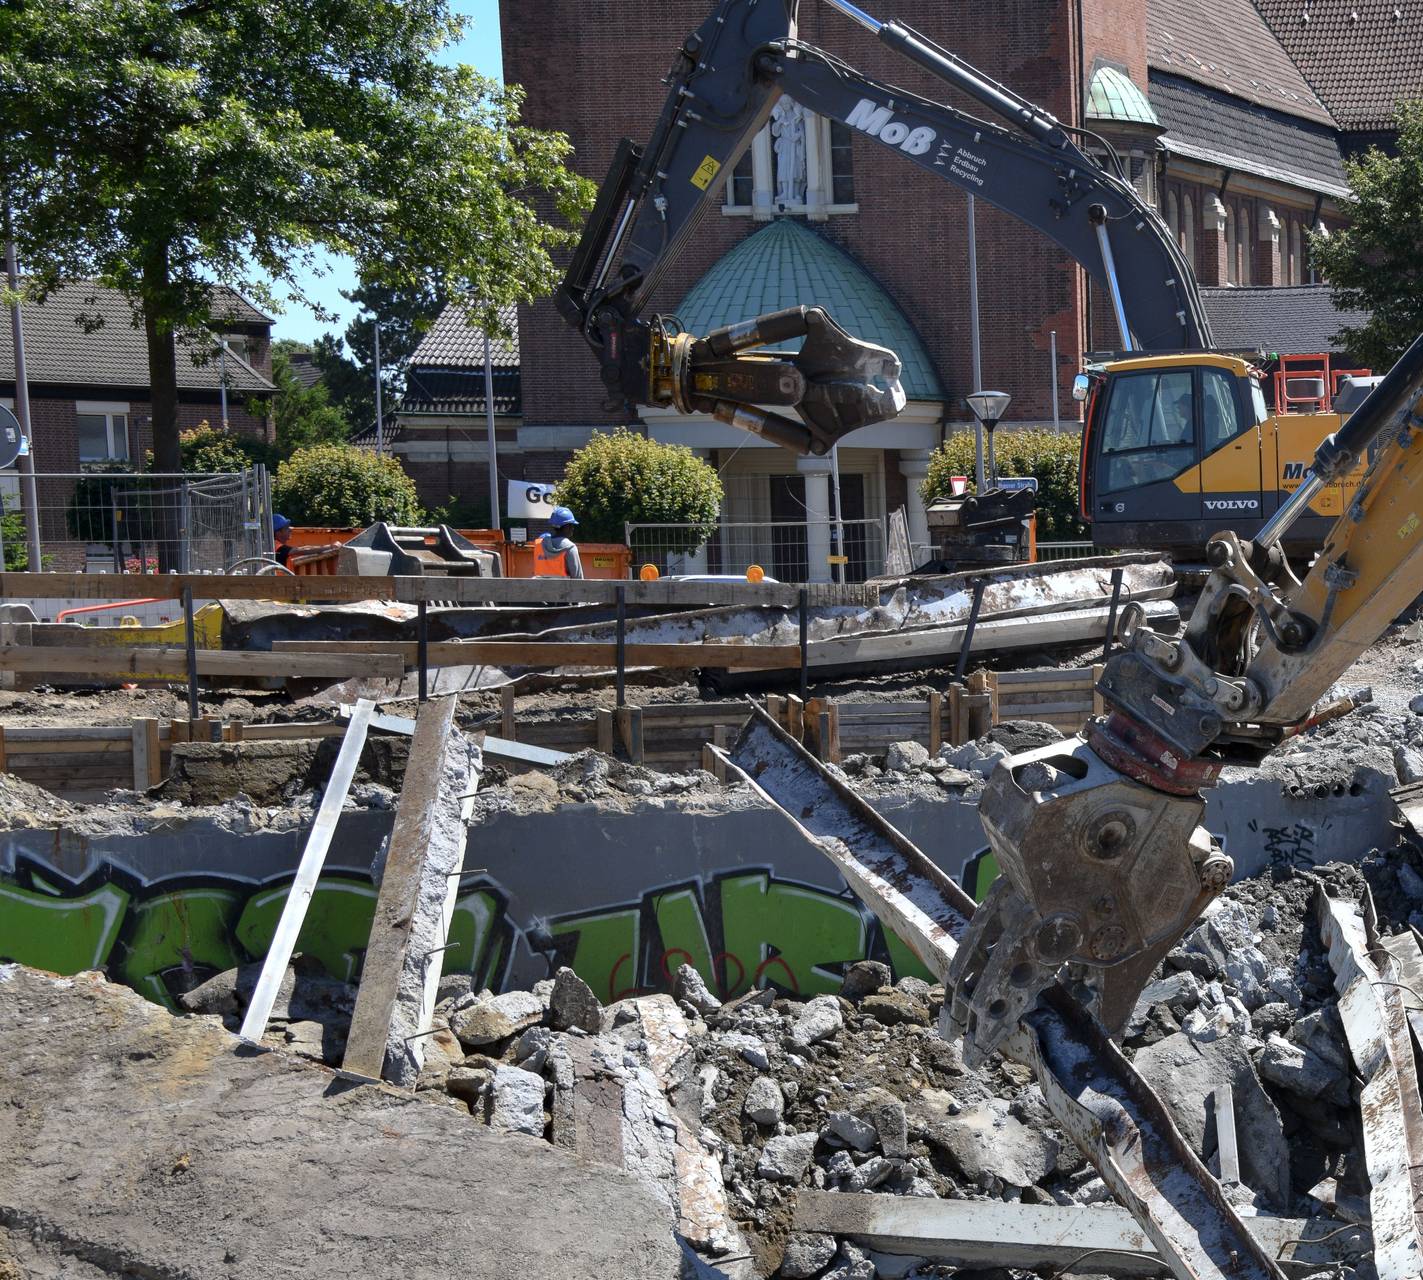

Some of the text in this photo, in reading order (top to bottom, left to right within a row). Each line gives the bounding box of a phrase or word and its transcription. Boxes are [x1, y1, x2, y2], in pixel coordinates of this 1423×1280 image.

[845, 98, 936, 155] Moß
[953, 156, 979, 173] Erdbau
[956, 147, 987, 167] Abbruch
[950, 164, 984, 186] Recycling
[1204, 500, 1258, 510] VOLVO
